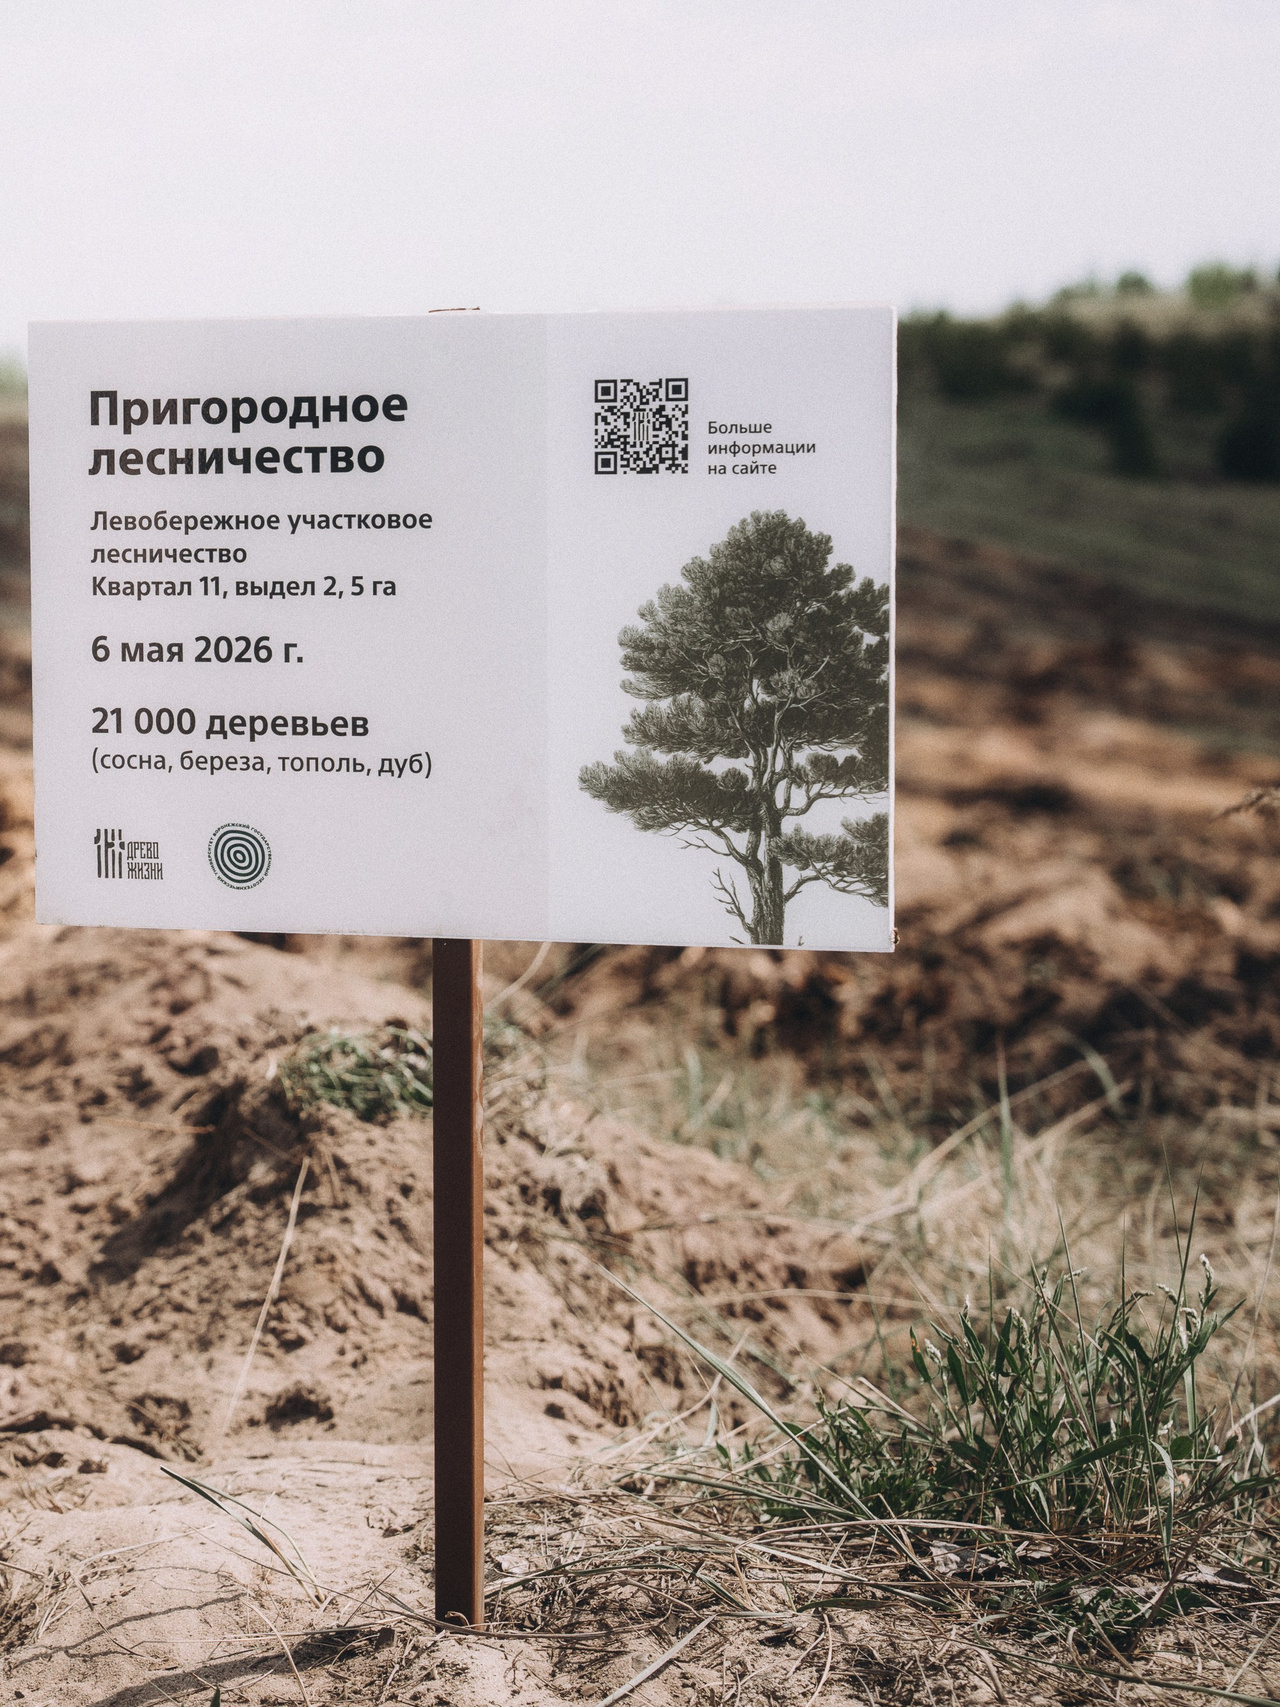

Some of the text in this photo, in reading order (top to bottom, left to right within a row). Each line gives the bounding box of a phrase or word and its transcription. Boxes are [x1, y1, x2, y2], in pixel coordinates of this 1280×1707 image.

[90, 390, 408, 435] Пригородное
[708, 420, 773, 435] Больше
[88, 444, 385, 476] лесничество
[708, 440, 816, 457] информации
[708, 460, 777, 475] на сайте
[90, 510, 433, 536] Левобережное участковое
[90, 547, 248, 564] лесничество
[92, 575, 397, 601] Квартал 11, выдел 2, 5 га
[91, 635, 304, 664] 6 мая 2026 г.
[91, 706, 369, 743] 21 000 деревьев
[92, 746, 432, 779] (сосна, береза, тополь, дуб)
[126, 841, 159, 860] ДРЕВО
[126, 862, 163, 880] ЖИЗНИ
